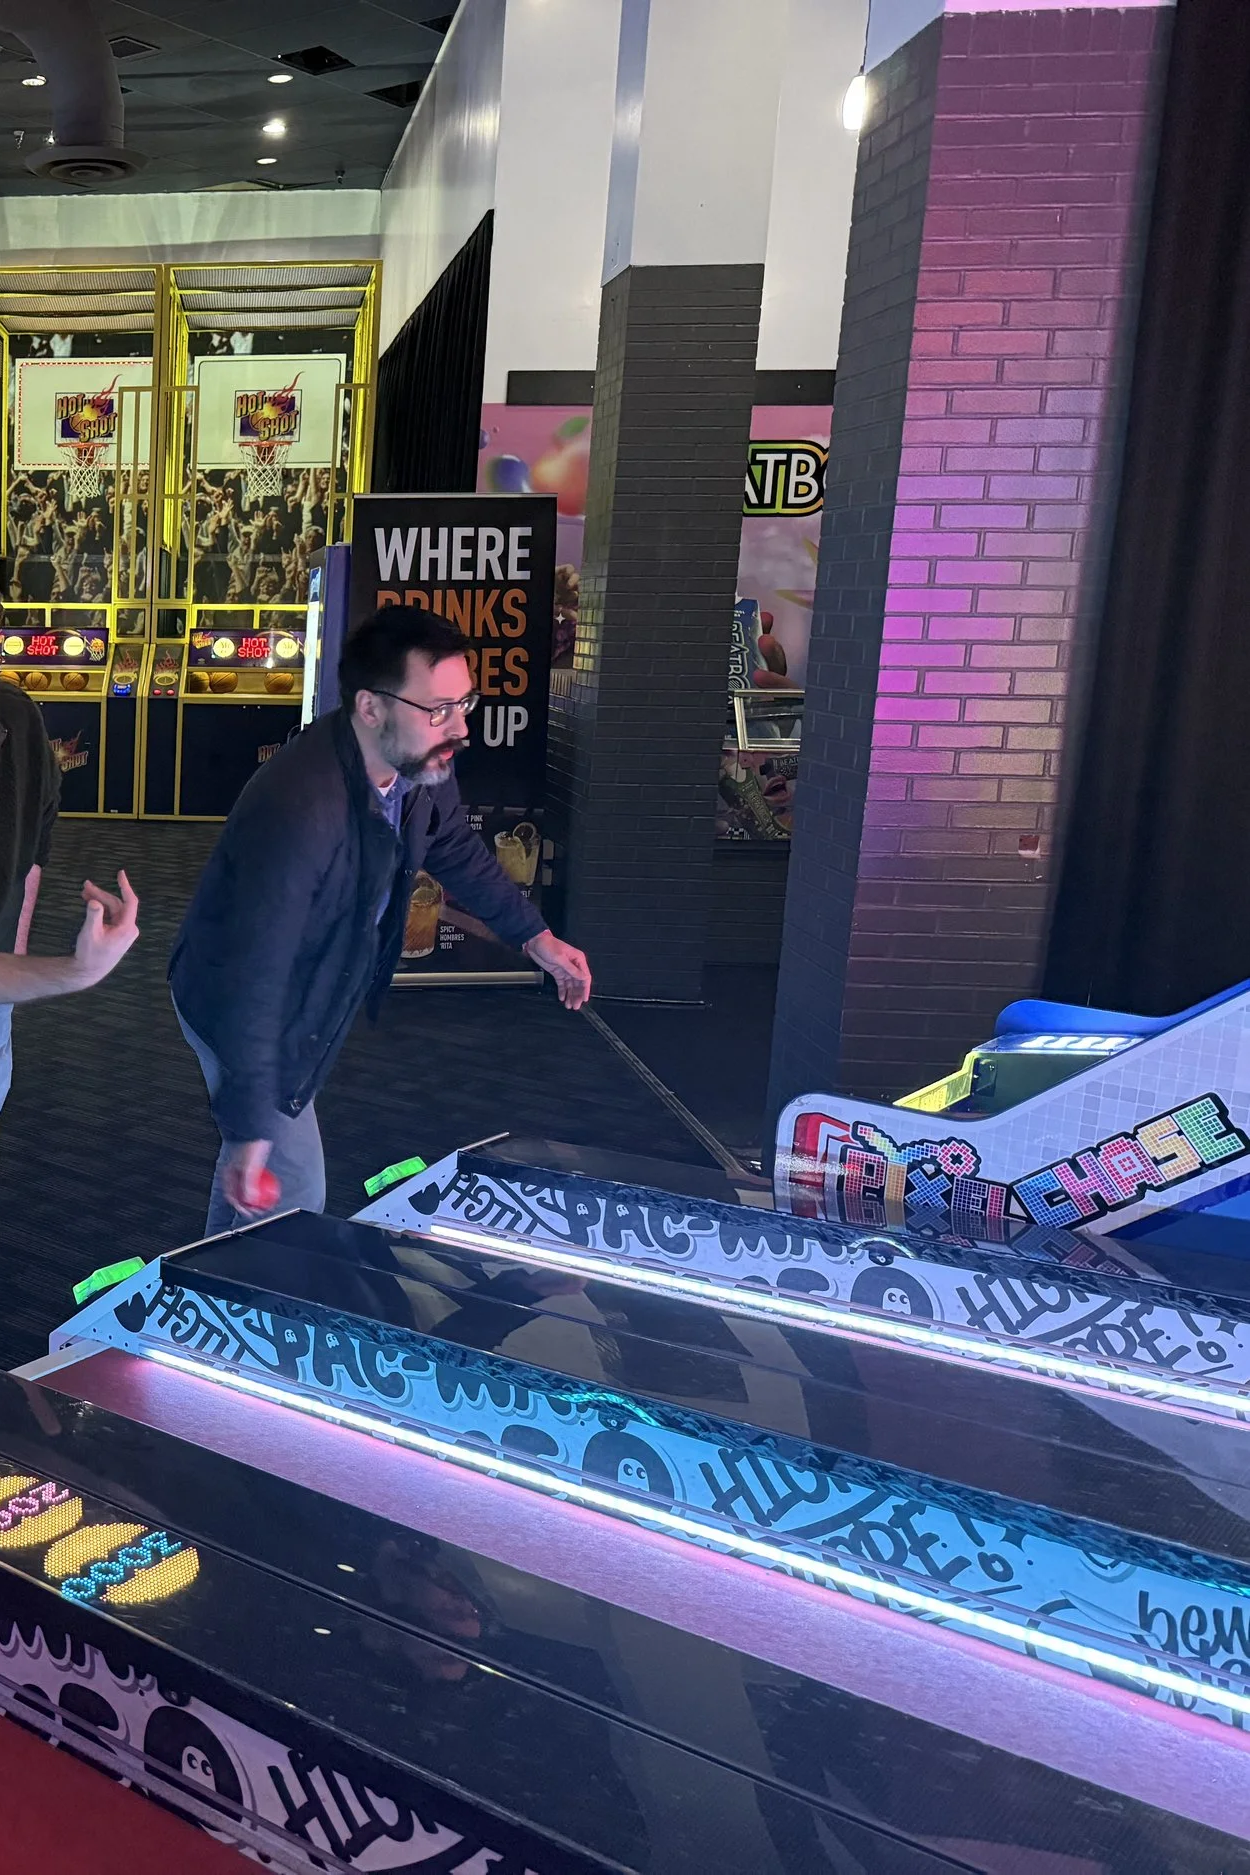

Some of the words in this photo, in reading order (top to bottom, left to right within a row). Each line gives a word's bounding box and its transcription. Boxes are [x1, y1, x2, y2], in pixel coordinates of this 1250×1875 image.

[56, 393, 85, 419] HOT
[235, 391, 265, 418] HOT
[80, 413, 118, 442] SHOT
[259, 411, 298, 441] SHOT
[374, 526, 533, 582] WHERE
[26, 645, 59, 656] SHOT
[31, 635, 57, 646] HOT
[237, 648, 271, 658] SHOT
[242, 637, 268, 648] HOT
[483, 705, 529, 748] UP
[439, 933, 465, 942] HOMBRES
[440, 925, 455, 933] SPICY
[844, 1140, 1022, 1221] PIXEL
[1014, 1096, 1246, 1230] CHASE
